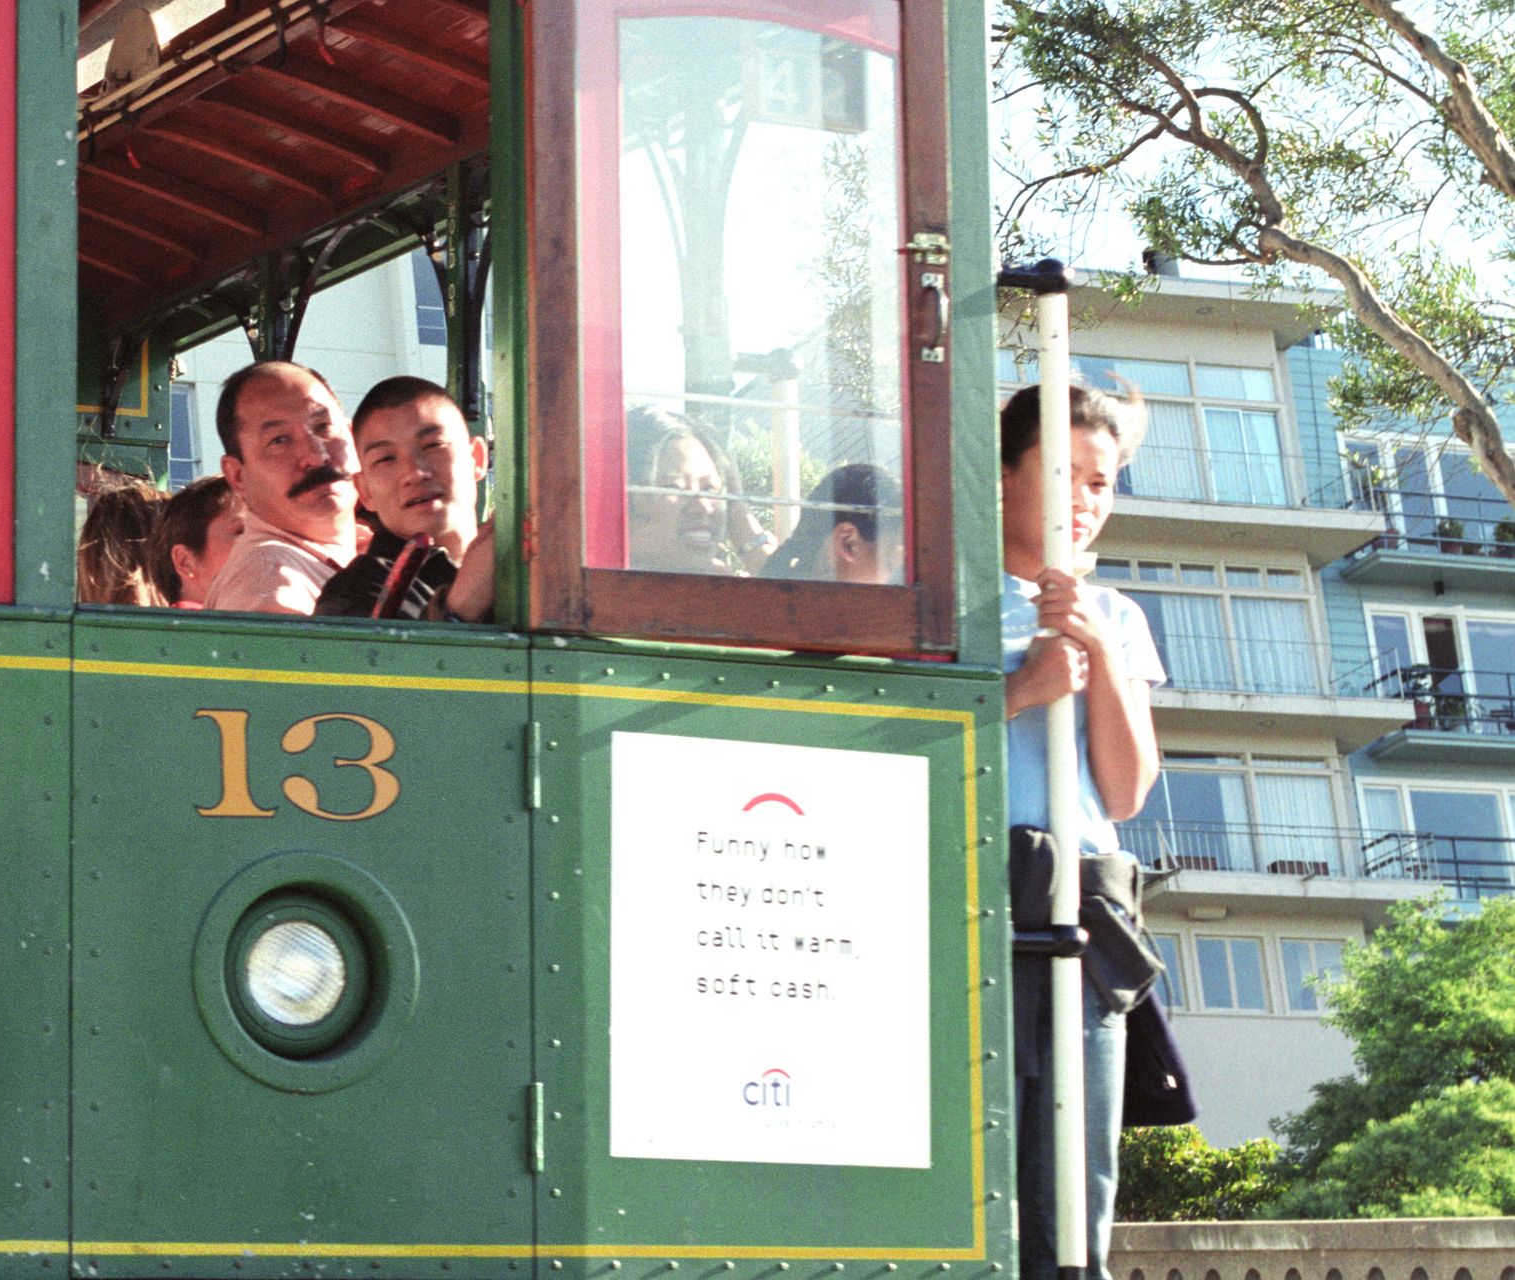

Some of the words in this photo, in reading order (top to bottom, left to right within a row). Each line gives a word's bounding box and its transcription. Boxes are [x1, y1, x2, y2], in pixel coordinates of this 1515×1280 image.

[192, 708, 401, 821] 13
[697, 830, 770, 862] Funny
[784, 838, 826, 861] how
[697, 879, 752, 908] they
[697, 926, 746, 949] call
[757, 928, 780, 951] it
[697, 973, 756, 996] soft
[742, 1076, 790, 1107] citi
